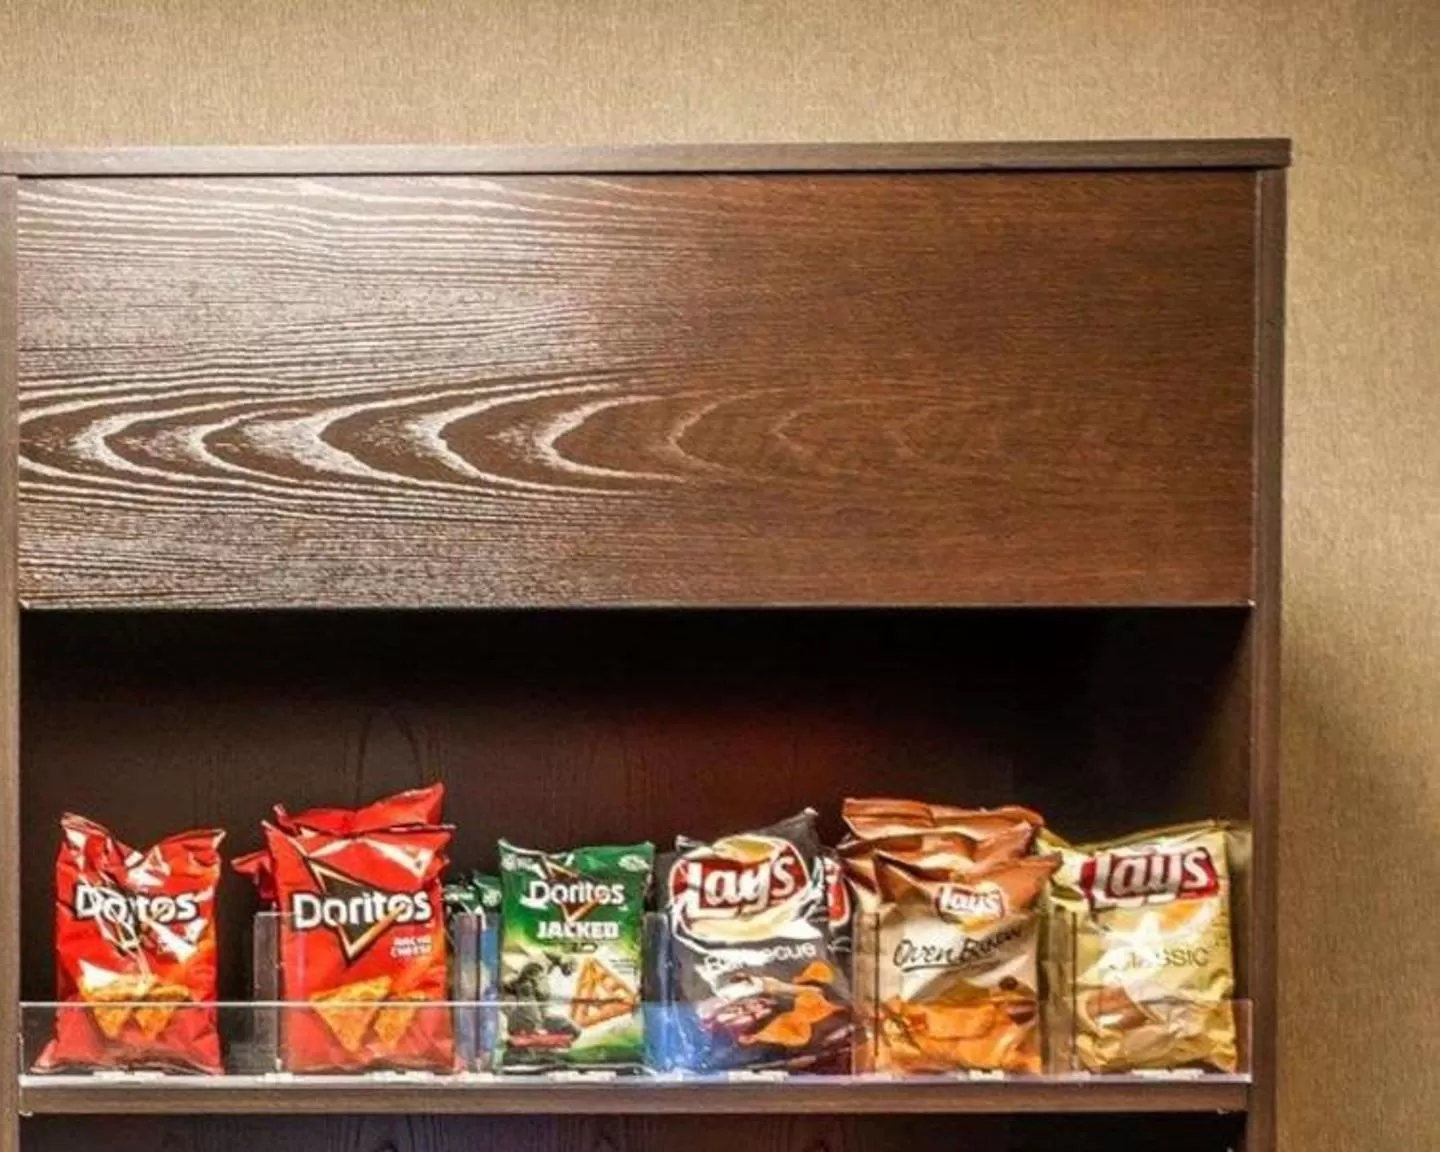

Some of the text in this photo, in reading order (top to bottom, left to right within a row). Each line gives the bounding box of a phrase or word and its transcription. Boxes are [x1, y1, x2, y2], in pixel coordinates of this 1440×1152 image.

[1090, 845, 1216, 908] Lay's
[528, 879, 625, 906] Doritos
[293, 889, 432, 930] Doritos
[536, 919, 621, 940] JACKED
[892, 939, 956, 968] Oven
